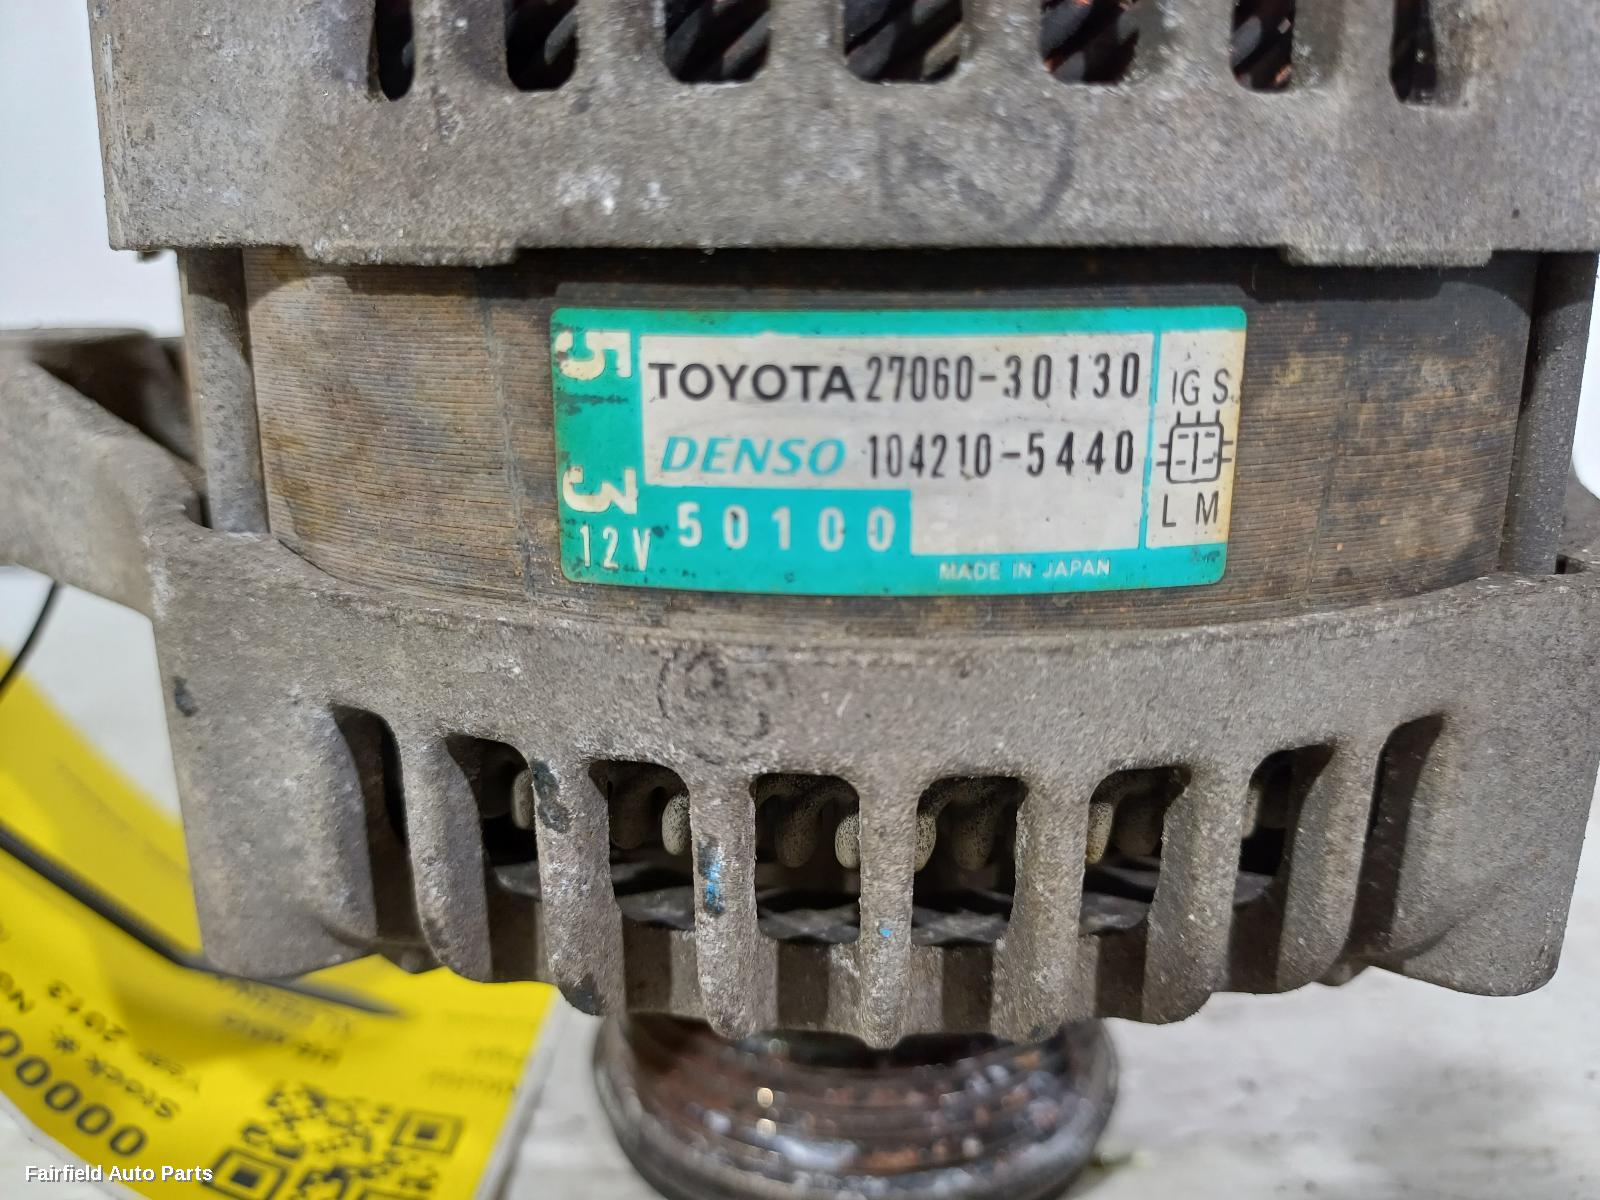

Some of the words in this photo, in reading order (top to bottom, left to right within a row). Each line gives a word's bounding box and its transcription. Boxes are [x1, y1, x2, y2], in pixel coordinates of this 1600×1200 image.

[555, 331, 631, 380] 5
[648, 363, 855, 402] TOYOTA
[866, 353, 1140, 402] 27060-30130
[1171, 370, 1200, 406] IG
[1212, 368, 1231, 405] S
[661, 436, 846, 476] DENSO
[868, 430, 1134, 478] 104210-5440
[562, 465, 638, 515] 3
[1161, 494, 1177, 527] L
[1195, 490, 1219, 525] M
[939, 563, 1000, 581] MADE
[1012, 562, 1033, 578] IN
[1042, 559, 1111, 578] JAPAN
[86, 1054, 181, 1120] Stock
